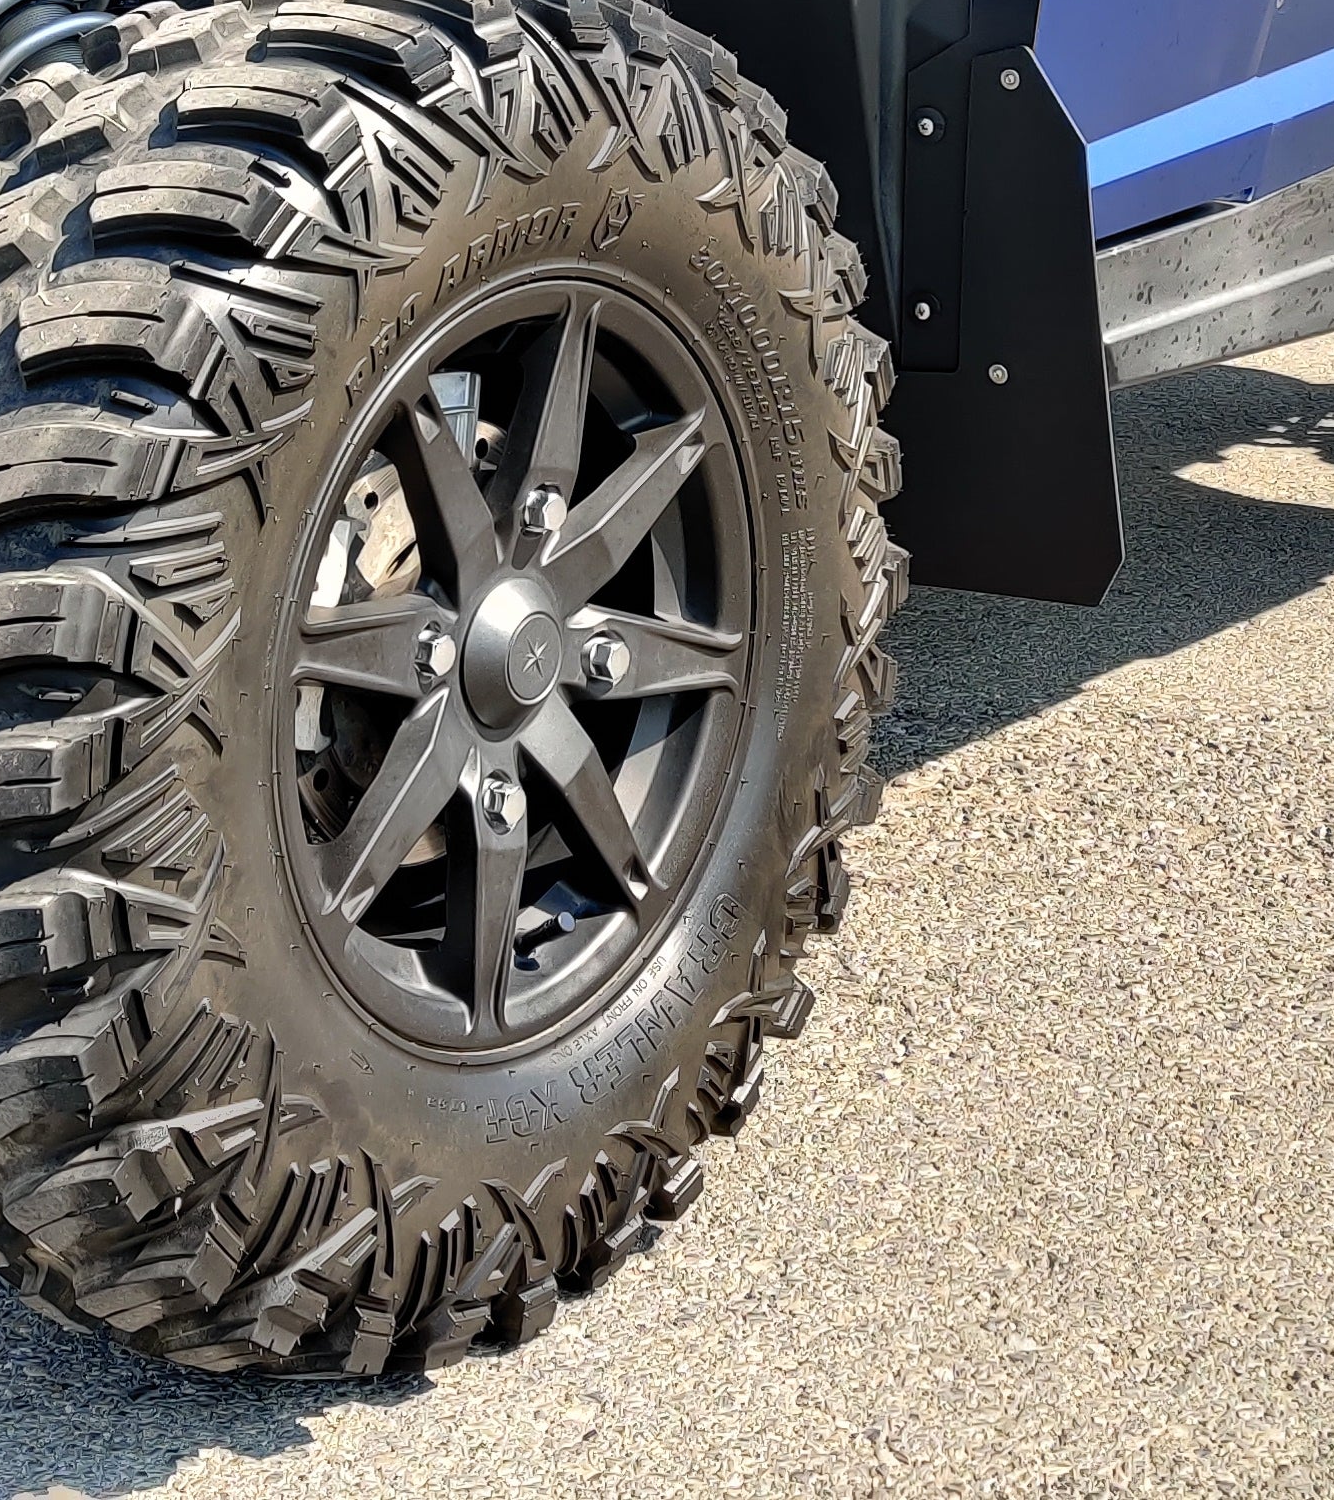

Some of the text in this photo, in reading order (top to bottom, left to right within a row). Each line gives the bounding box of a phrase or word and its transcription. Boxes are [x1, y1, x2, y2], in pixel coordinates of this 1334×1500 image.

[647, 955, 668, 980] USE
[631, 978, 649, 997] ON
[604, 995, 634, 1029] FRONT
[572, 1025, 600, 1051] AXLE
